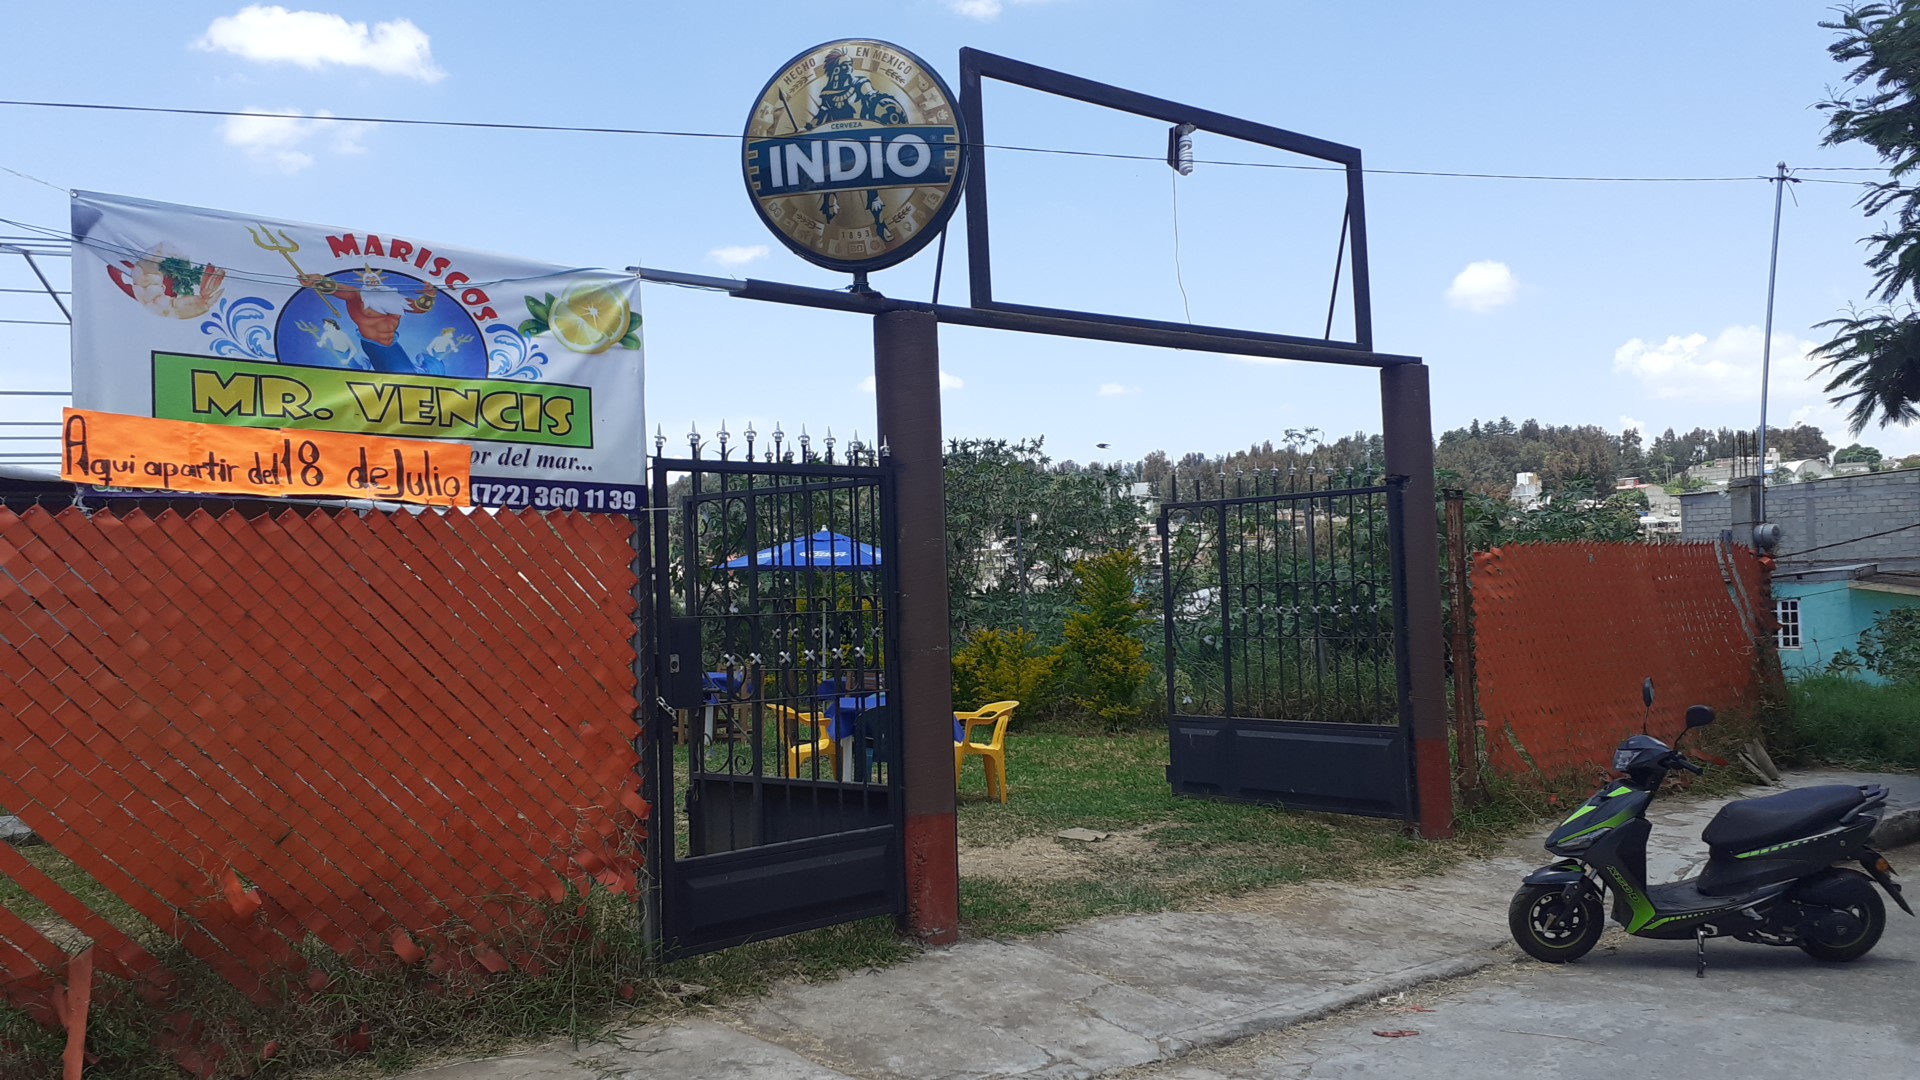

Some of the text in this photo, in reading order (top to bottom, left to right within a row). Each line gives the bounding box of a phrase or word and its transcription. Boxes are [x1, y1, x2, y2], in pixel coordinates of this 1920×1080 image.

[783, 47, 913, 86] HECHO EN MEXICO
[830, 121, 863, 130] CERVEZA
[769, 133, 931, 188] INDIO
[325, 233, 499, 321] MARISCOS
[191, 369, 574, 436] MR. VENCIS
[65, 415, 136, 486] Aqui
[281, 439, 324, 487] 18
[347, 447, 391, 489] de
[374, 449, 460, 498] Julio
[497, 447, 531, 467] del
[536, 457, 593, 471] mar...
[471, 483, 637, 510] (722) 360 11 39
